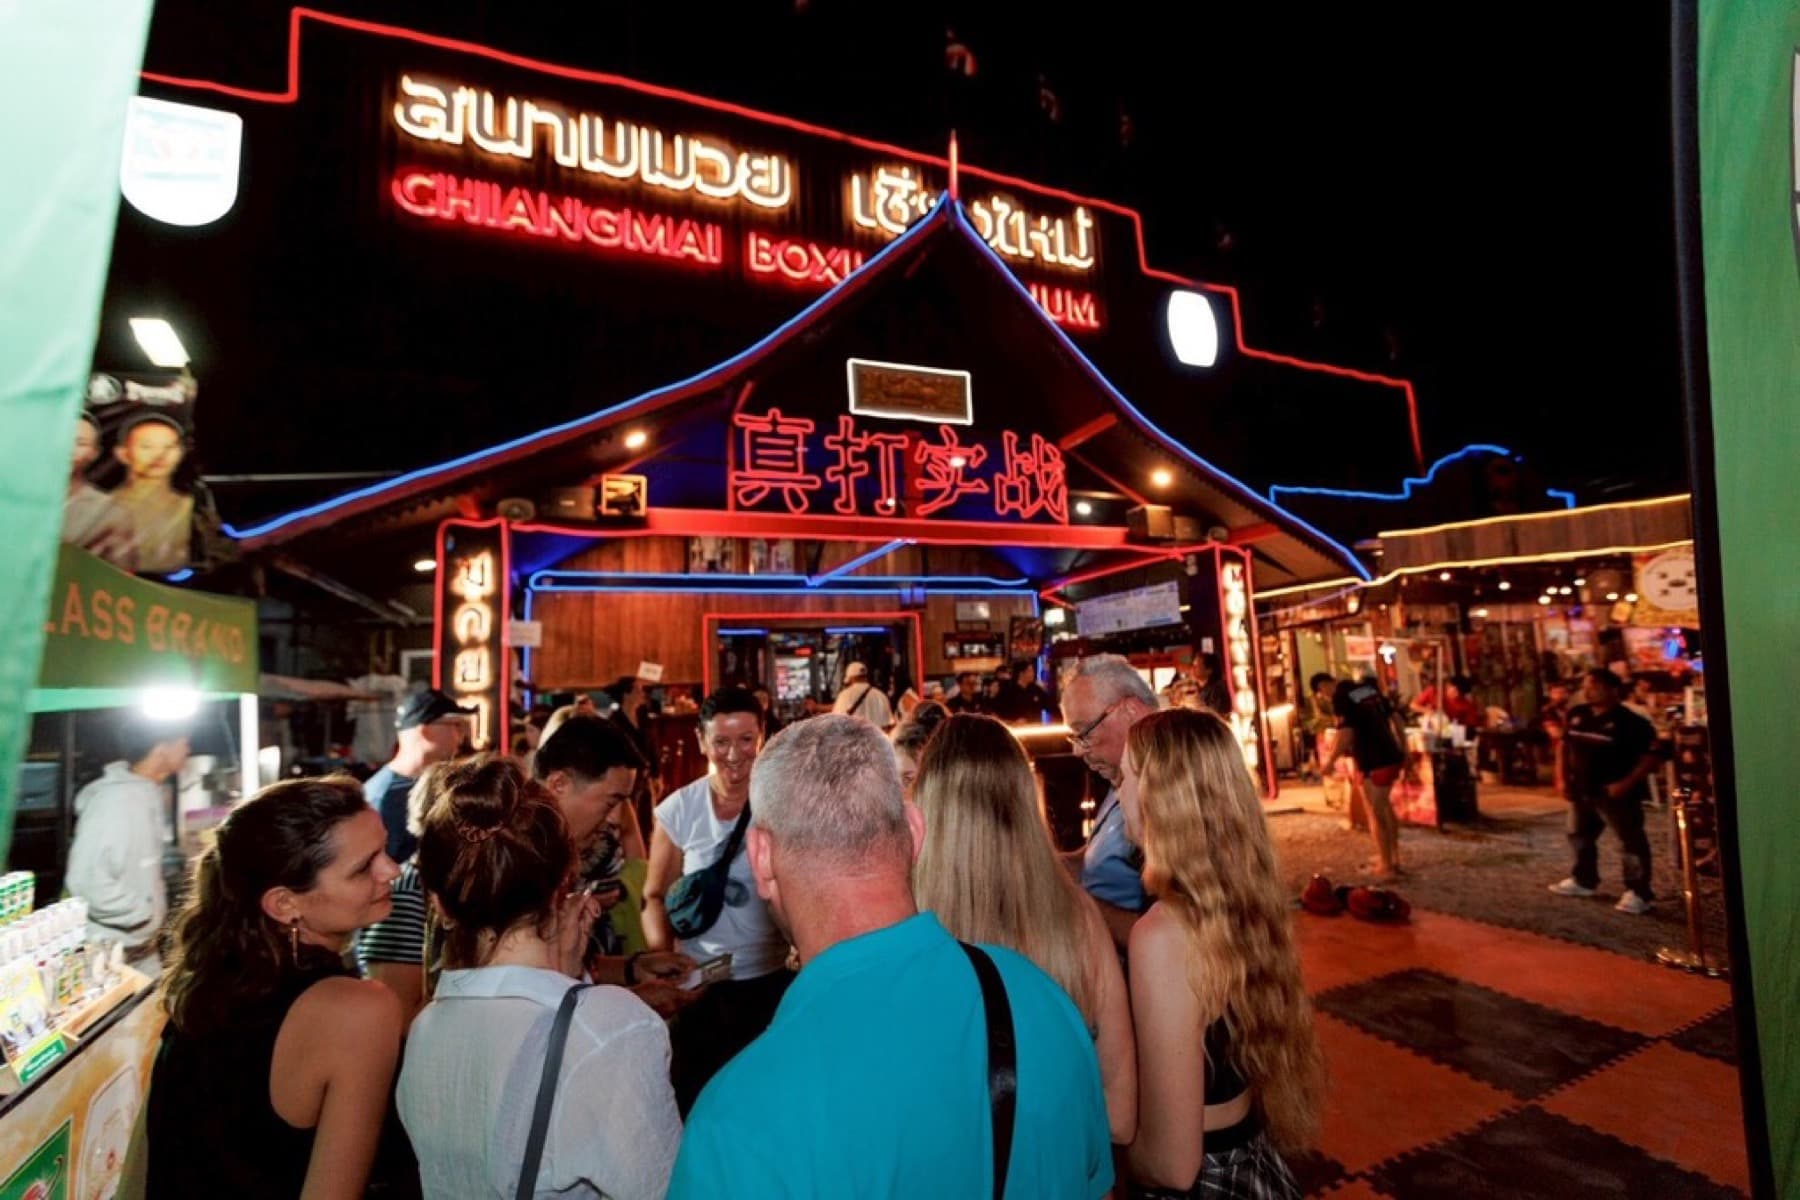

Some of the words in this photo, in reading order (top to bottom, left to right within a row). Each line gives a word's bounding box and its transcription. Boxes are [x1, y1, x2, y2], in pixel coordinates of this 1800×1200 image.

[391, 172, 722, 263] CHIANGMAI
[748, 232, 862, 284] BOXI
[733, 407, 1068, 523] 真打实战
[44, 581, 136, 645] ASS
